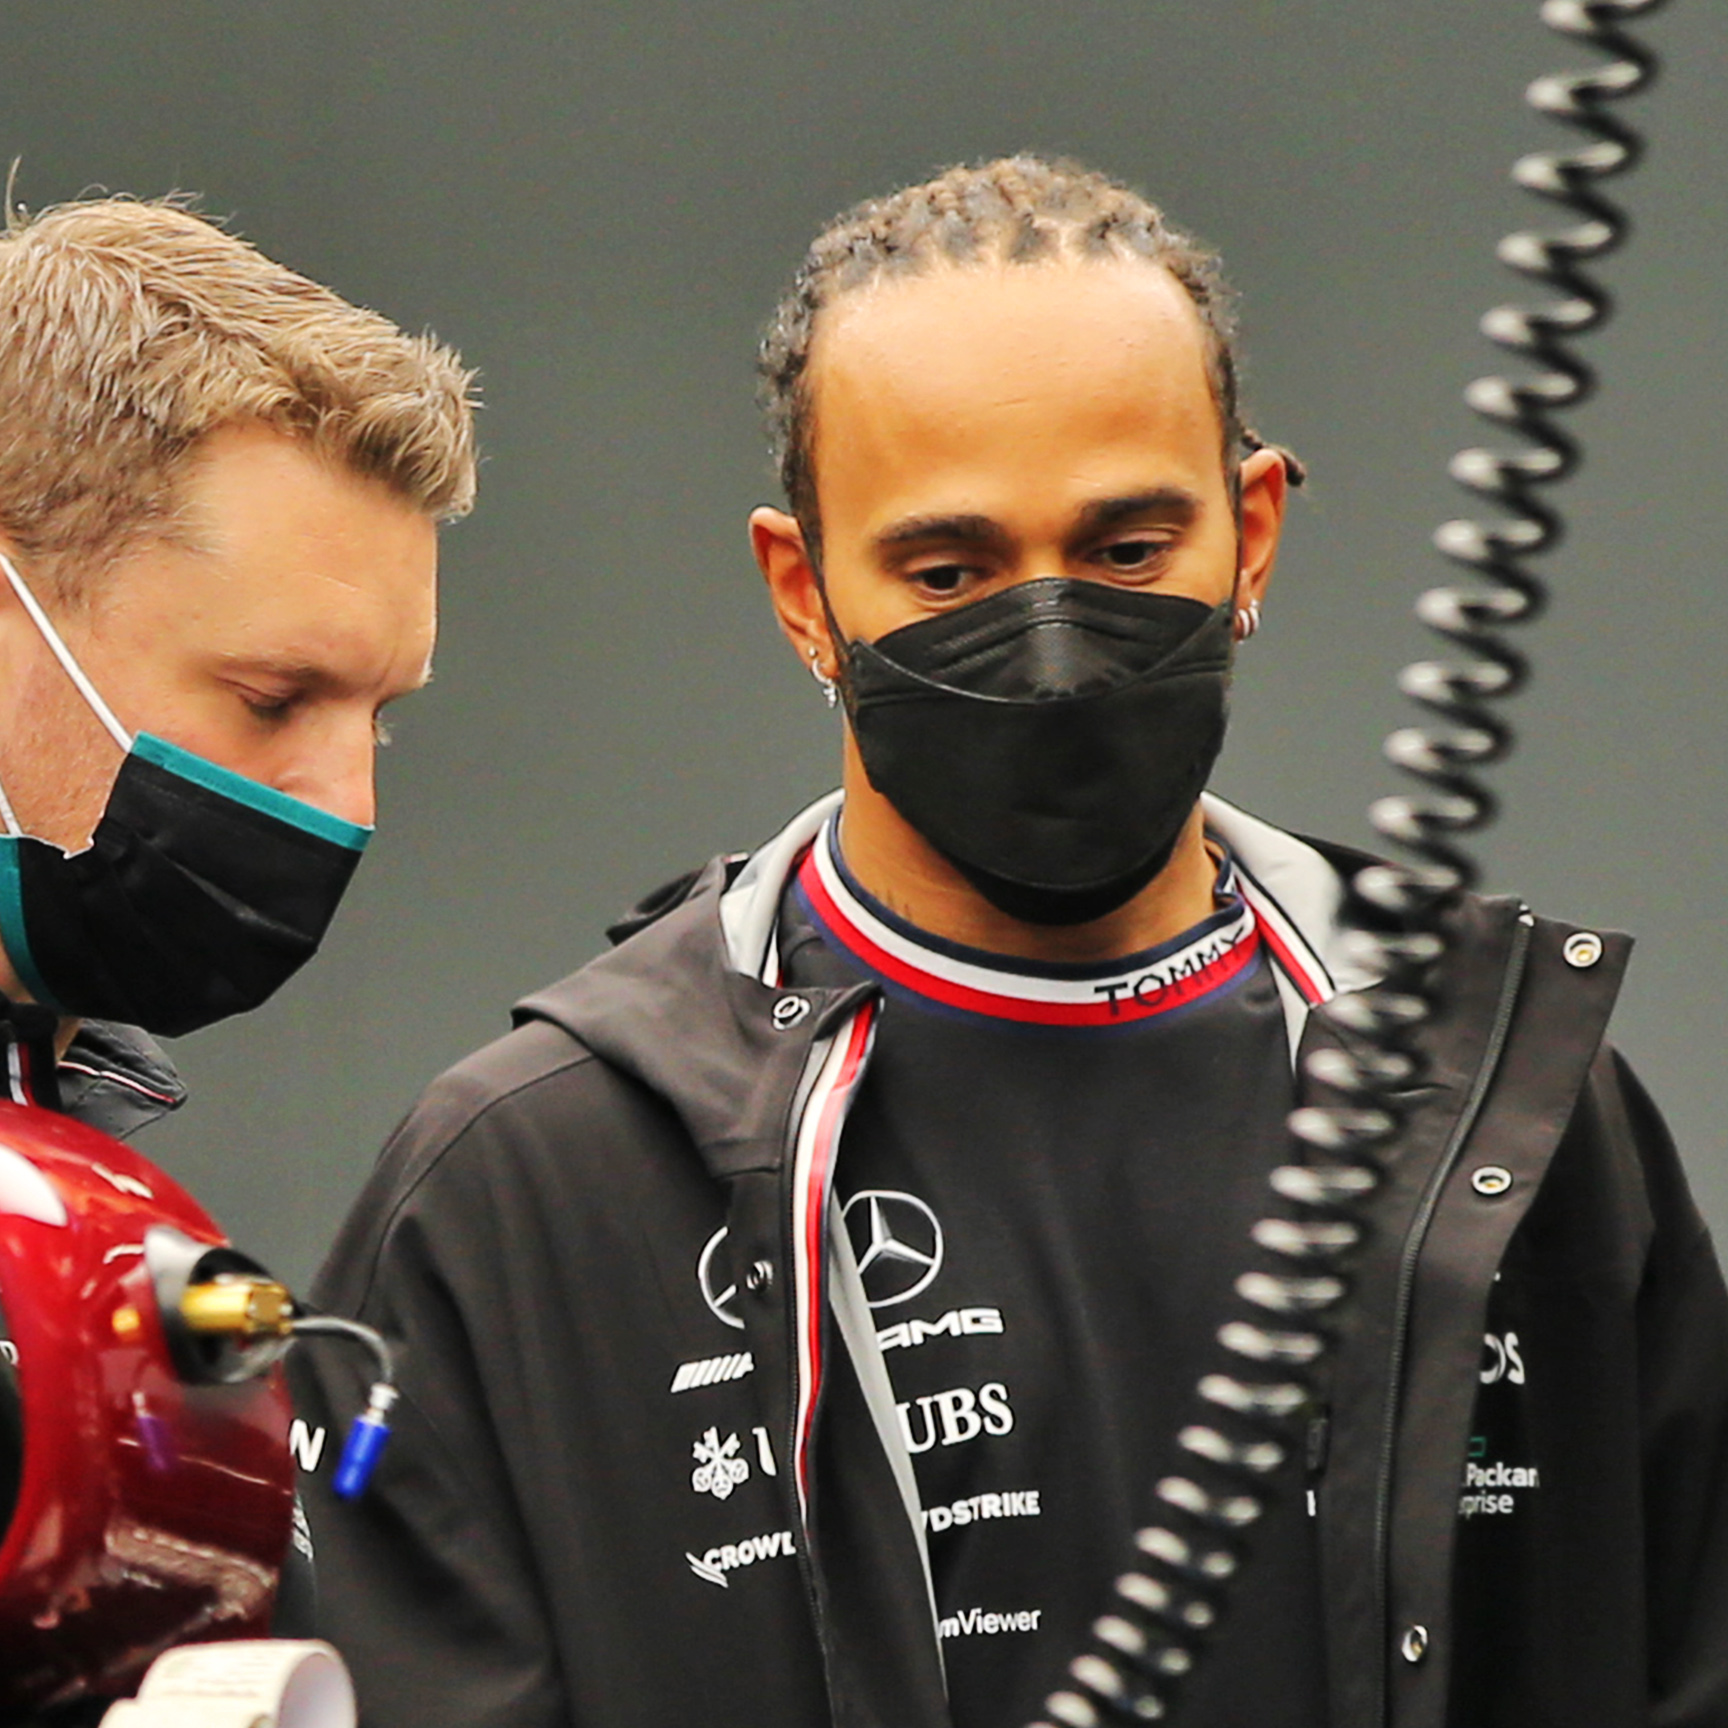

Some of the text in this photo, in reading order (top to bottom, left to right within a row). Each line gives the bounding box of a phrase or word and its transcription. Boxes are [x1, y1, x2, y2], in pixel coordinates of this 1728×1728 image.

[1094, 926, 1244, 1016] TOMMY
[875, 1307, 1005, 1351] AMG
[896, 1382, 1015, 1454] UBS
